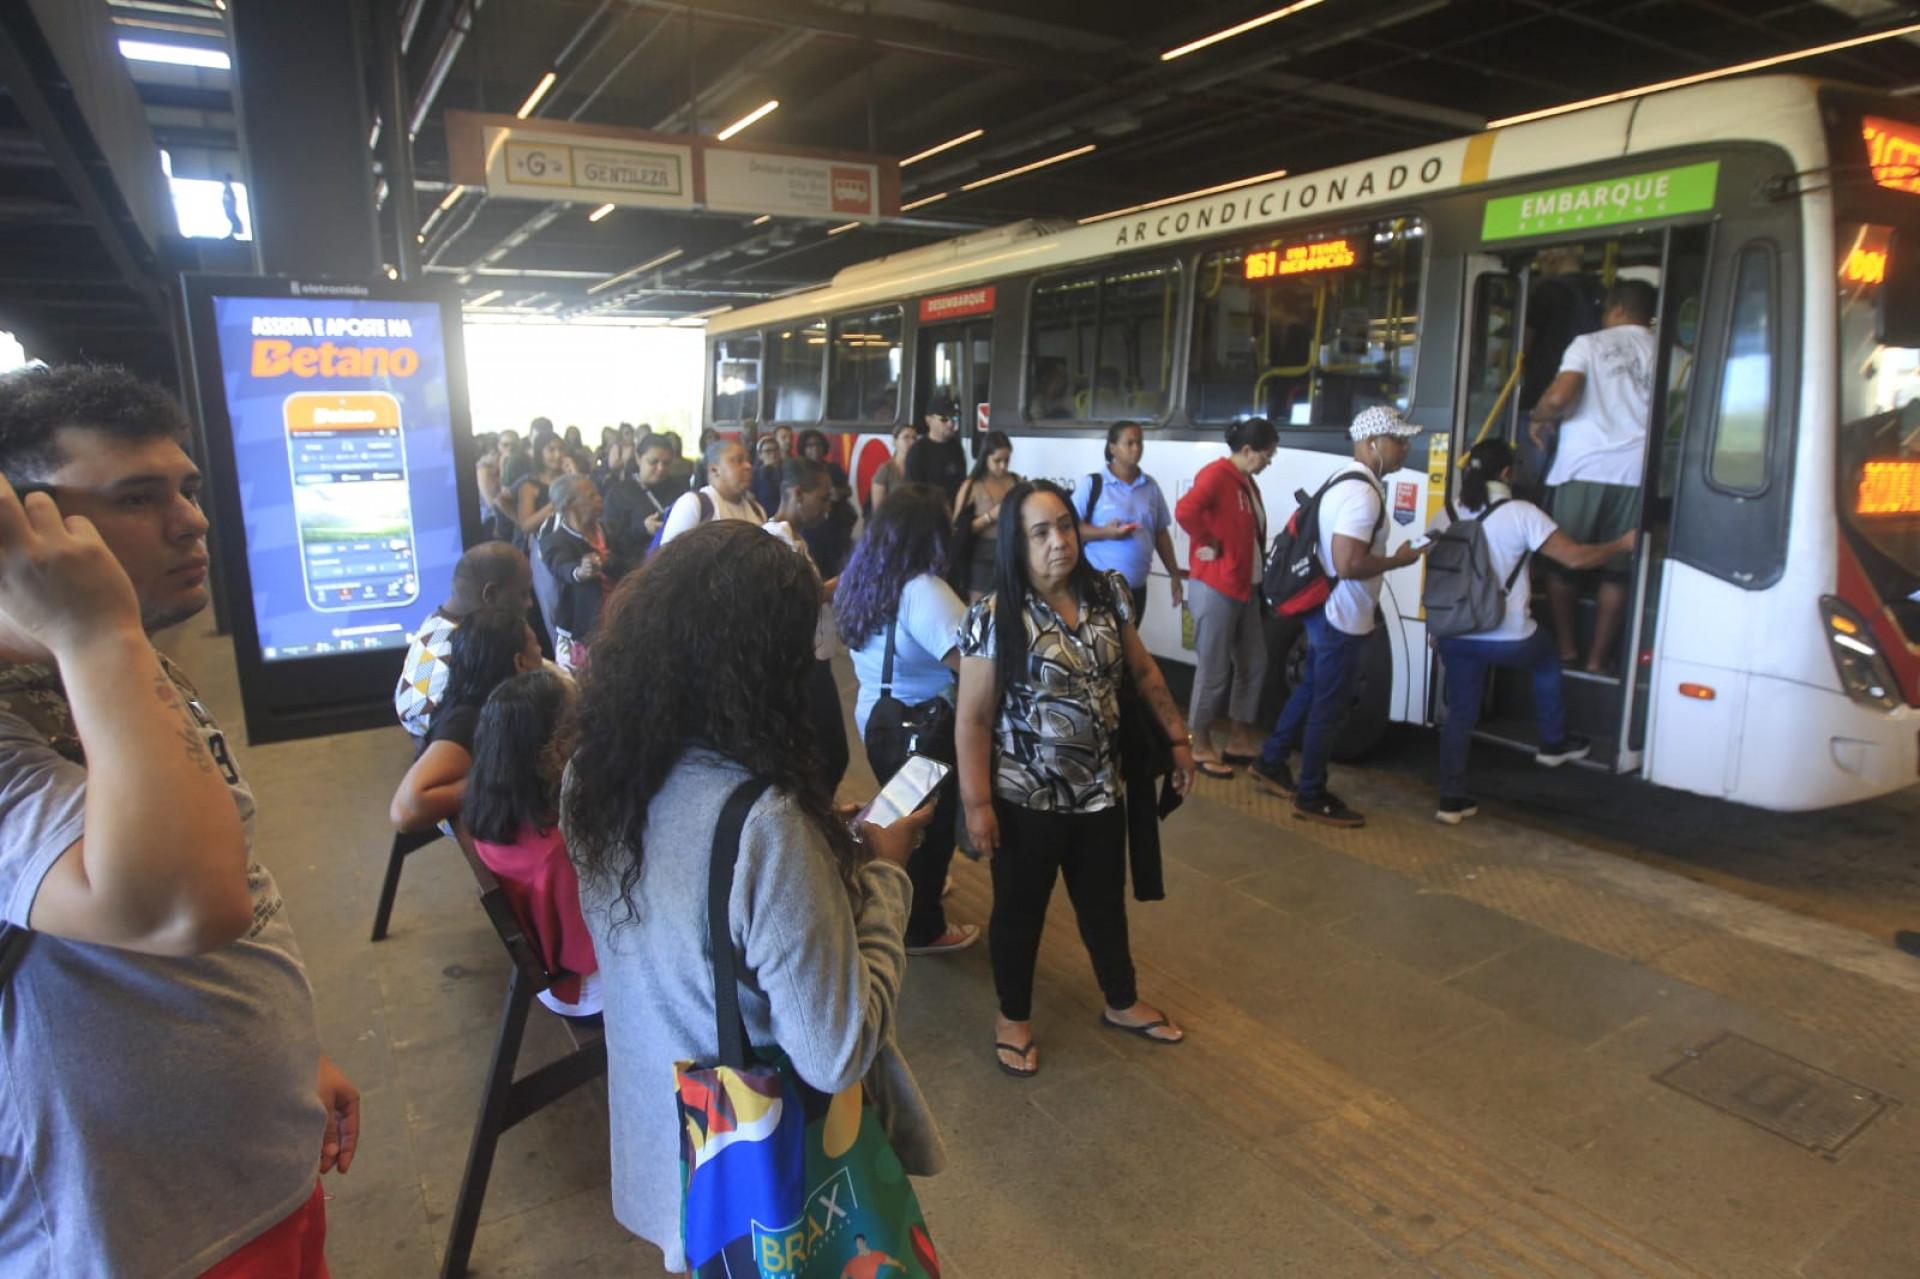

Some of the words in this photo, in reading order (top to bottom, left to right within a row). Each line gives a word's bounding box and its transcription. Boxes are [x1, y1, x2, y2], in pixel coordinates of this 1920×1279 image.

[584, 162, 669, 187] GENTILEZA
[1520, 174, 1671, 219] EMBARQUE
[927, 290, 986, 312] DESEMBARQUE
[251, 317, 313, 336] ASSISTA
[312, 318, 324, 336] E
[326, 318, 387, 337] APOSTE
[387, 319, 413, 338] NA
[251, 338, 420, 378] Betano
[761, 1182, 847, 1273] BRAX
